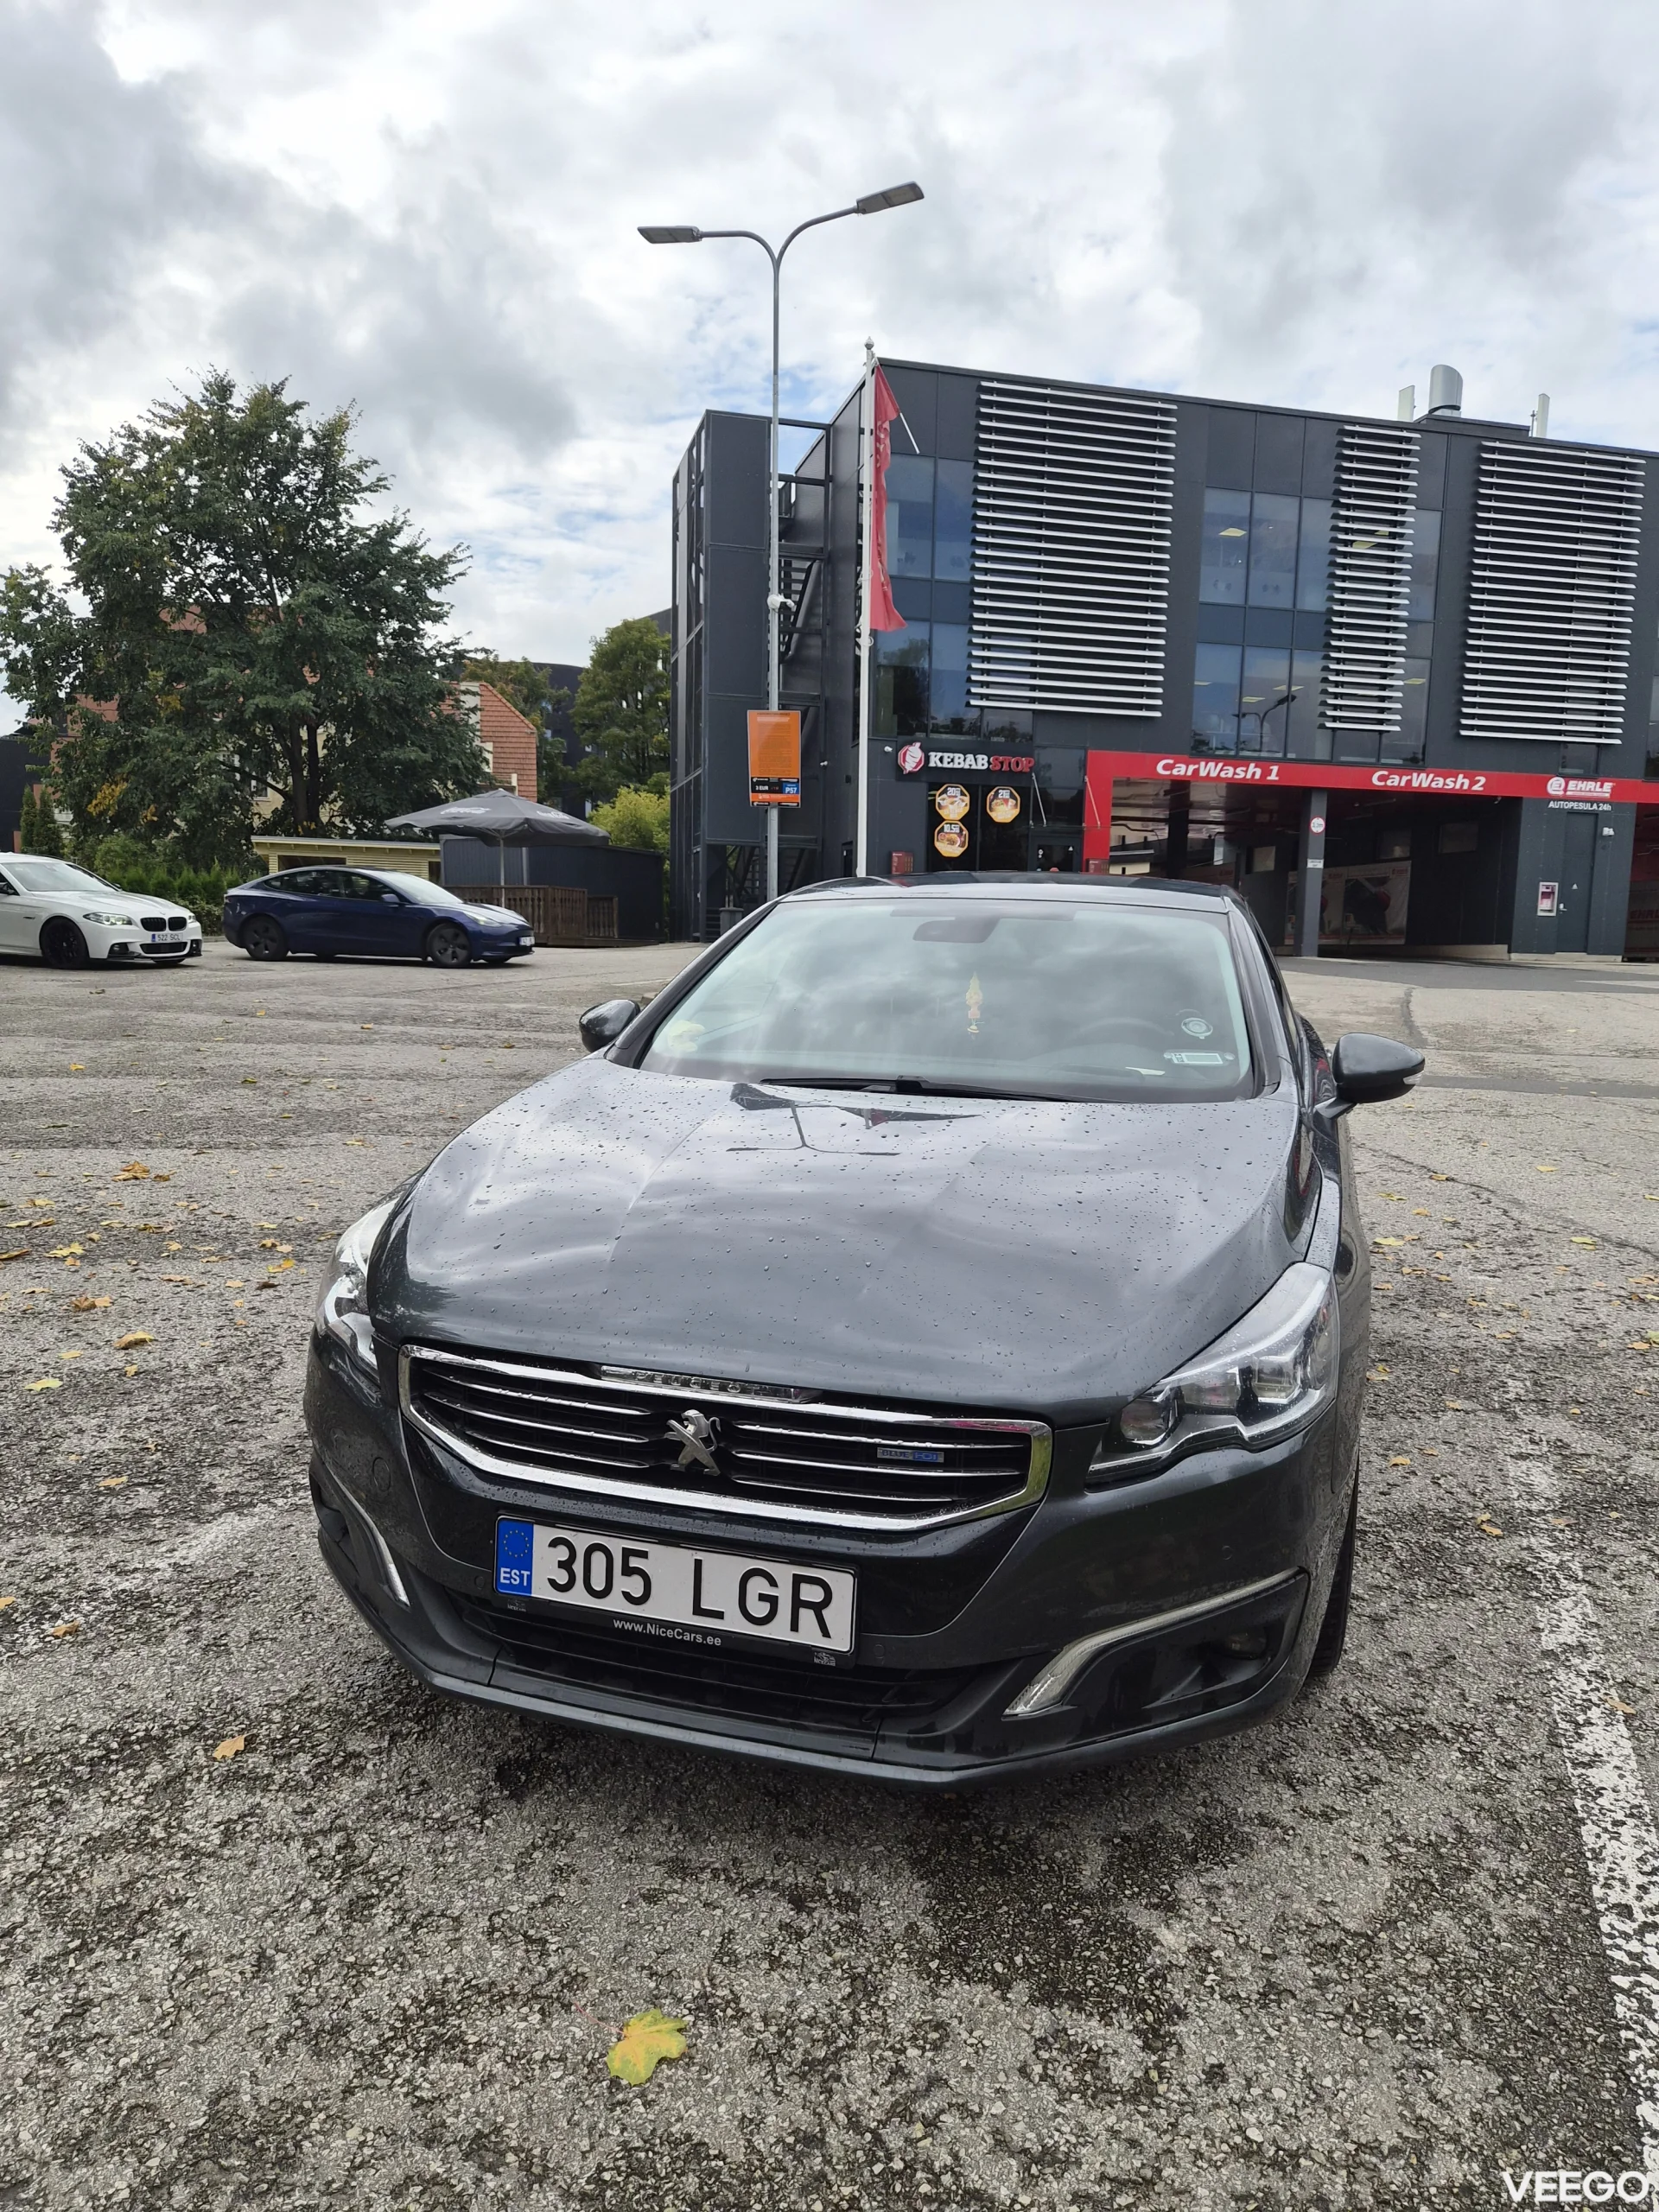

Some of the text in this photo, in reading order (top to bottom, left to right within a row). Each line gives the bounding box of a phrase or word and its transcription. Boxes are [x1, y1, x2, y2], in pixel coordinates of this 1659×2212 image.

[928, 752, 1035, 772] KEBAB STOP
[1156, 759, 1280, 780] CarWash 1
[1371, 770, 1486, 791] CarWash 2
[1567, 780, 1614, 792] EHRLE
[1548, 800, 1612, 811] AUTOPESULA 24h
[881, 1449, 910, 1459] BLUE
[499, 1567, 531, 1586] EST
[547, 1536, 833, 1639] 305 LGR
[613, 1618, 722, 1646] www.NiceCars.ee
